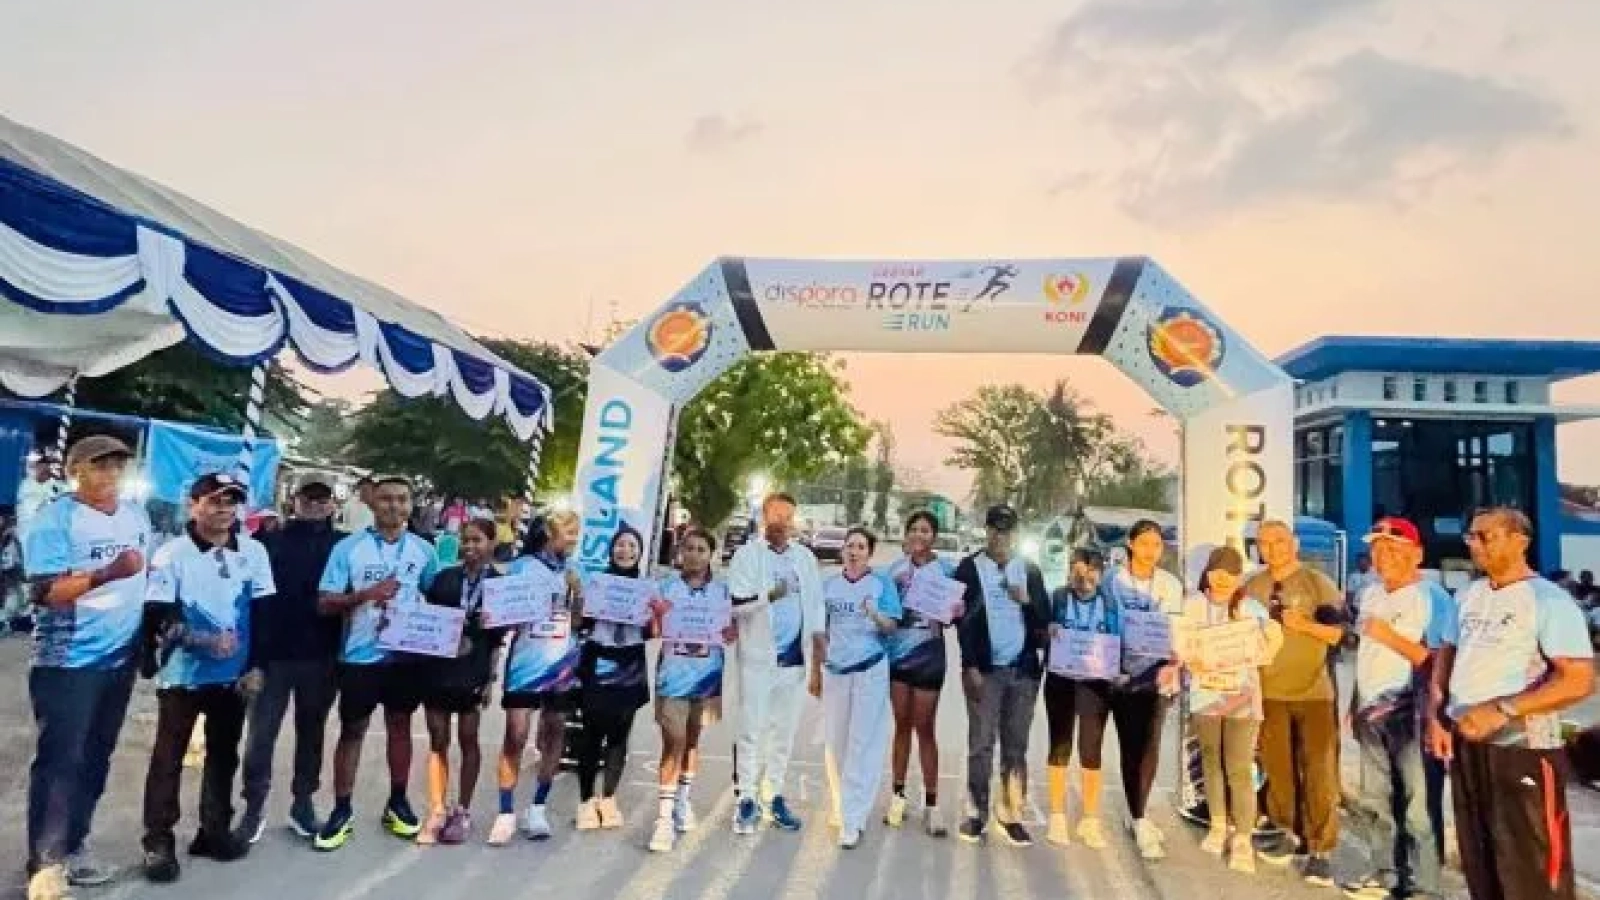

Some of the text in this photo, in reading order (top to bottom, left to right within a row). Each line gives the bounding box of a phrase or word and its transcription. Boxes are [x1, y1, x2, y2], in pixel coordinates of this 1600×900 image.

[866, 283, 951, 309] ROTE
[907, 314, 950, 330] RUN
[580, 399, 633, 572] ISLAND
[1226, 425, 1267, 547] ROT
